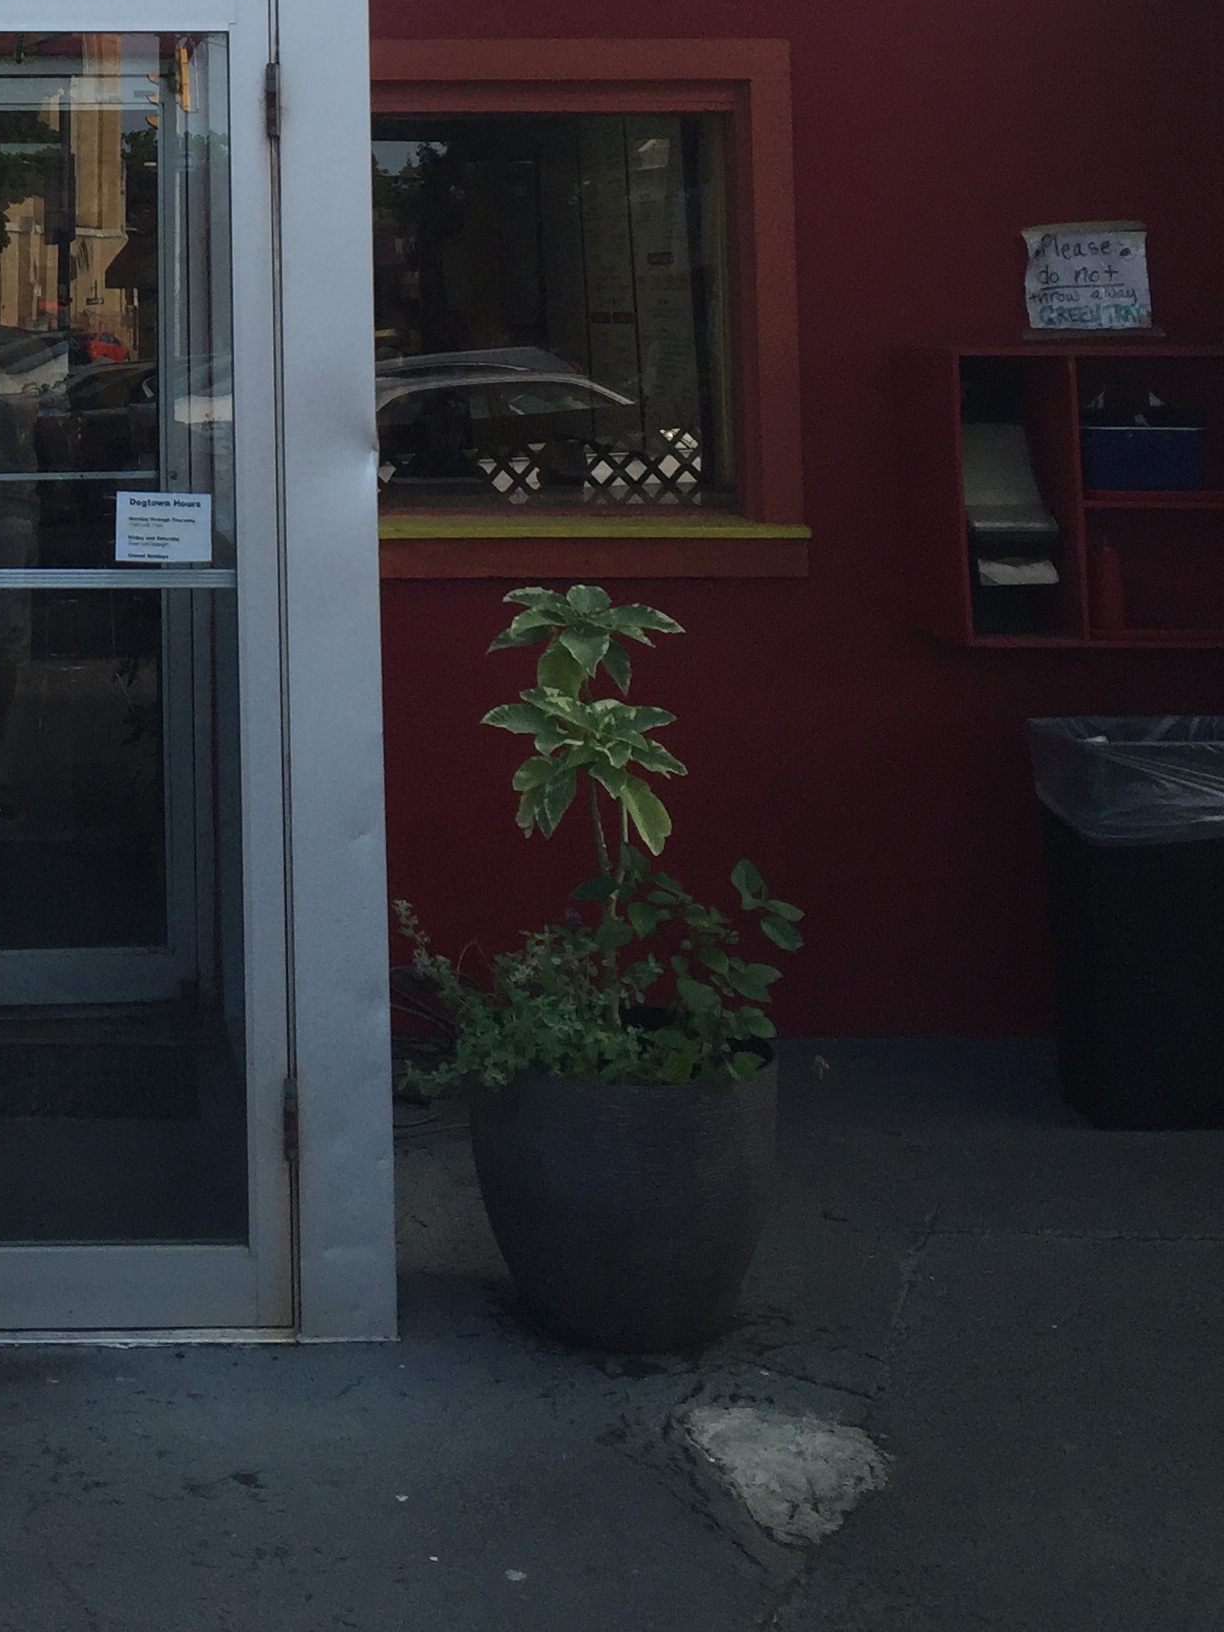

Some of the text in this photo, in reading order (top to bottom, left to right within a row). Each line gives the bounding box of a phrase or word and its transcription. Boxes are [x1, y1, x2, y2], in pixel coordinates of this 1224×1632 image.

[1039, 233, 1111, 260] Please
[1037, 264, 1119, 285] do not
[1028, 289, 1138, 305] throw away
